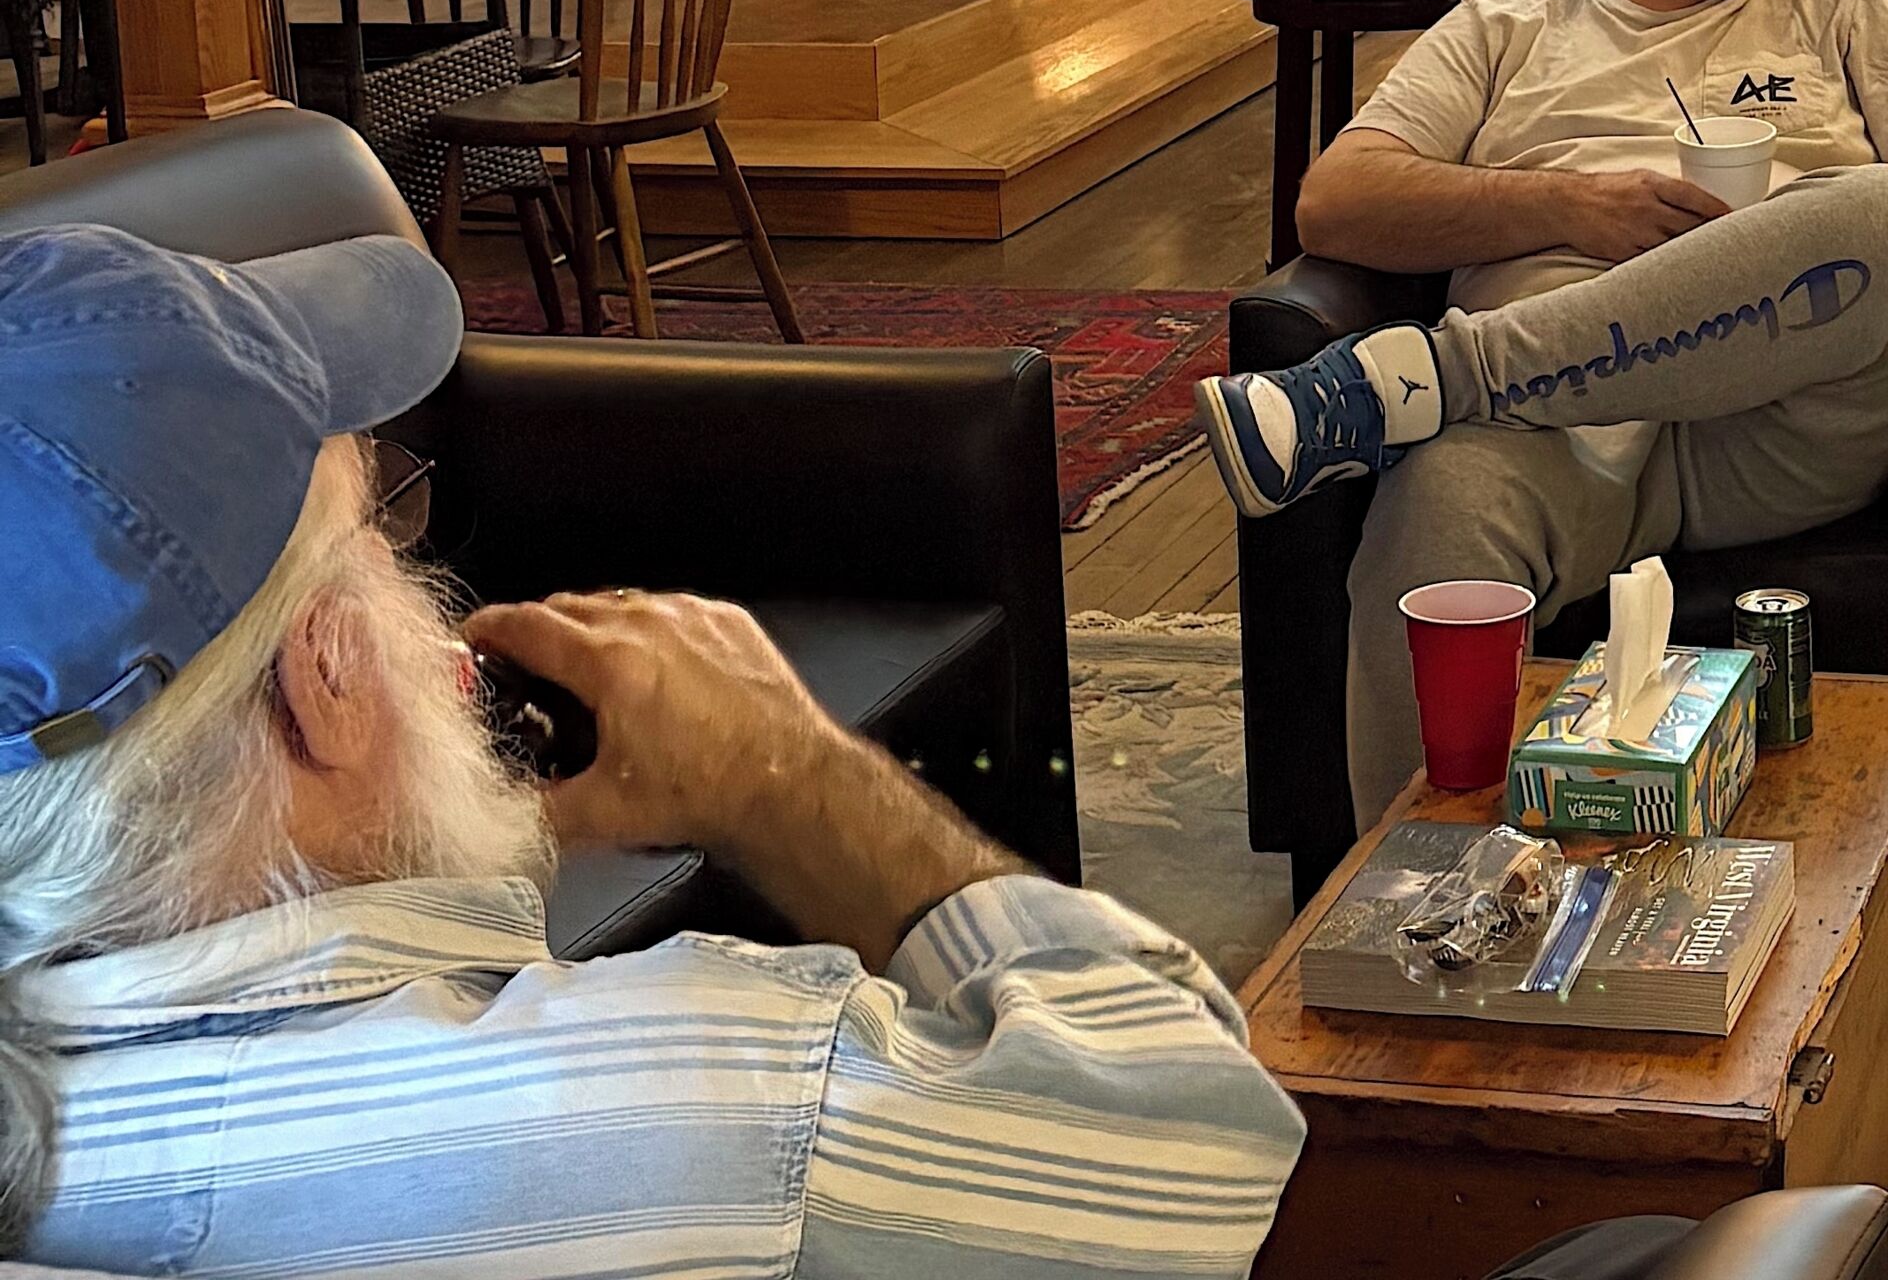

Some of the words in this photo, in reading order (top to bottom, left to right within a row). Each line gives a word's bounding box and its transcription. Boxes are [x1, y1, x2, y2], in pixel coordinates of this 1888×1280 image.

[1730, 72, 1798, 105] AE
[1491, 258, 1872, 413] Champion
[1567, 800, 1622, 822] Kleenex
[1722, 845, 1776, 889] West
[1680, 892, 1753, 966] Virginia
